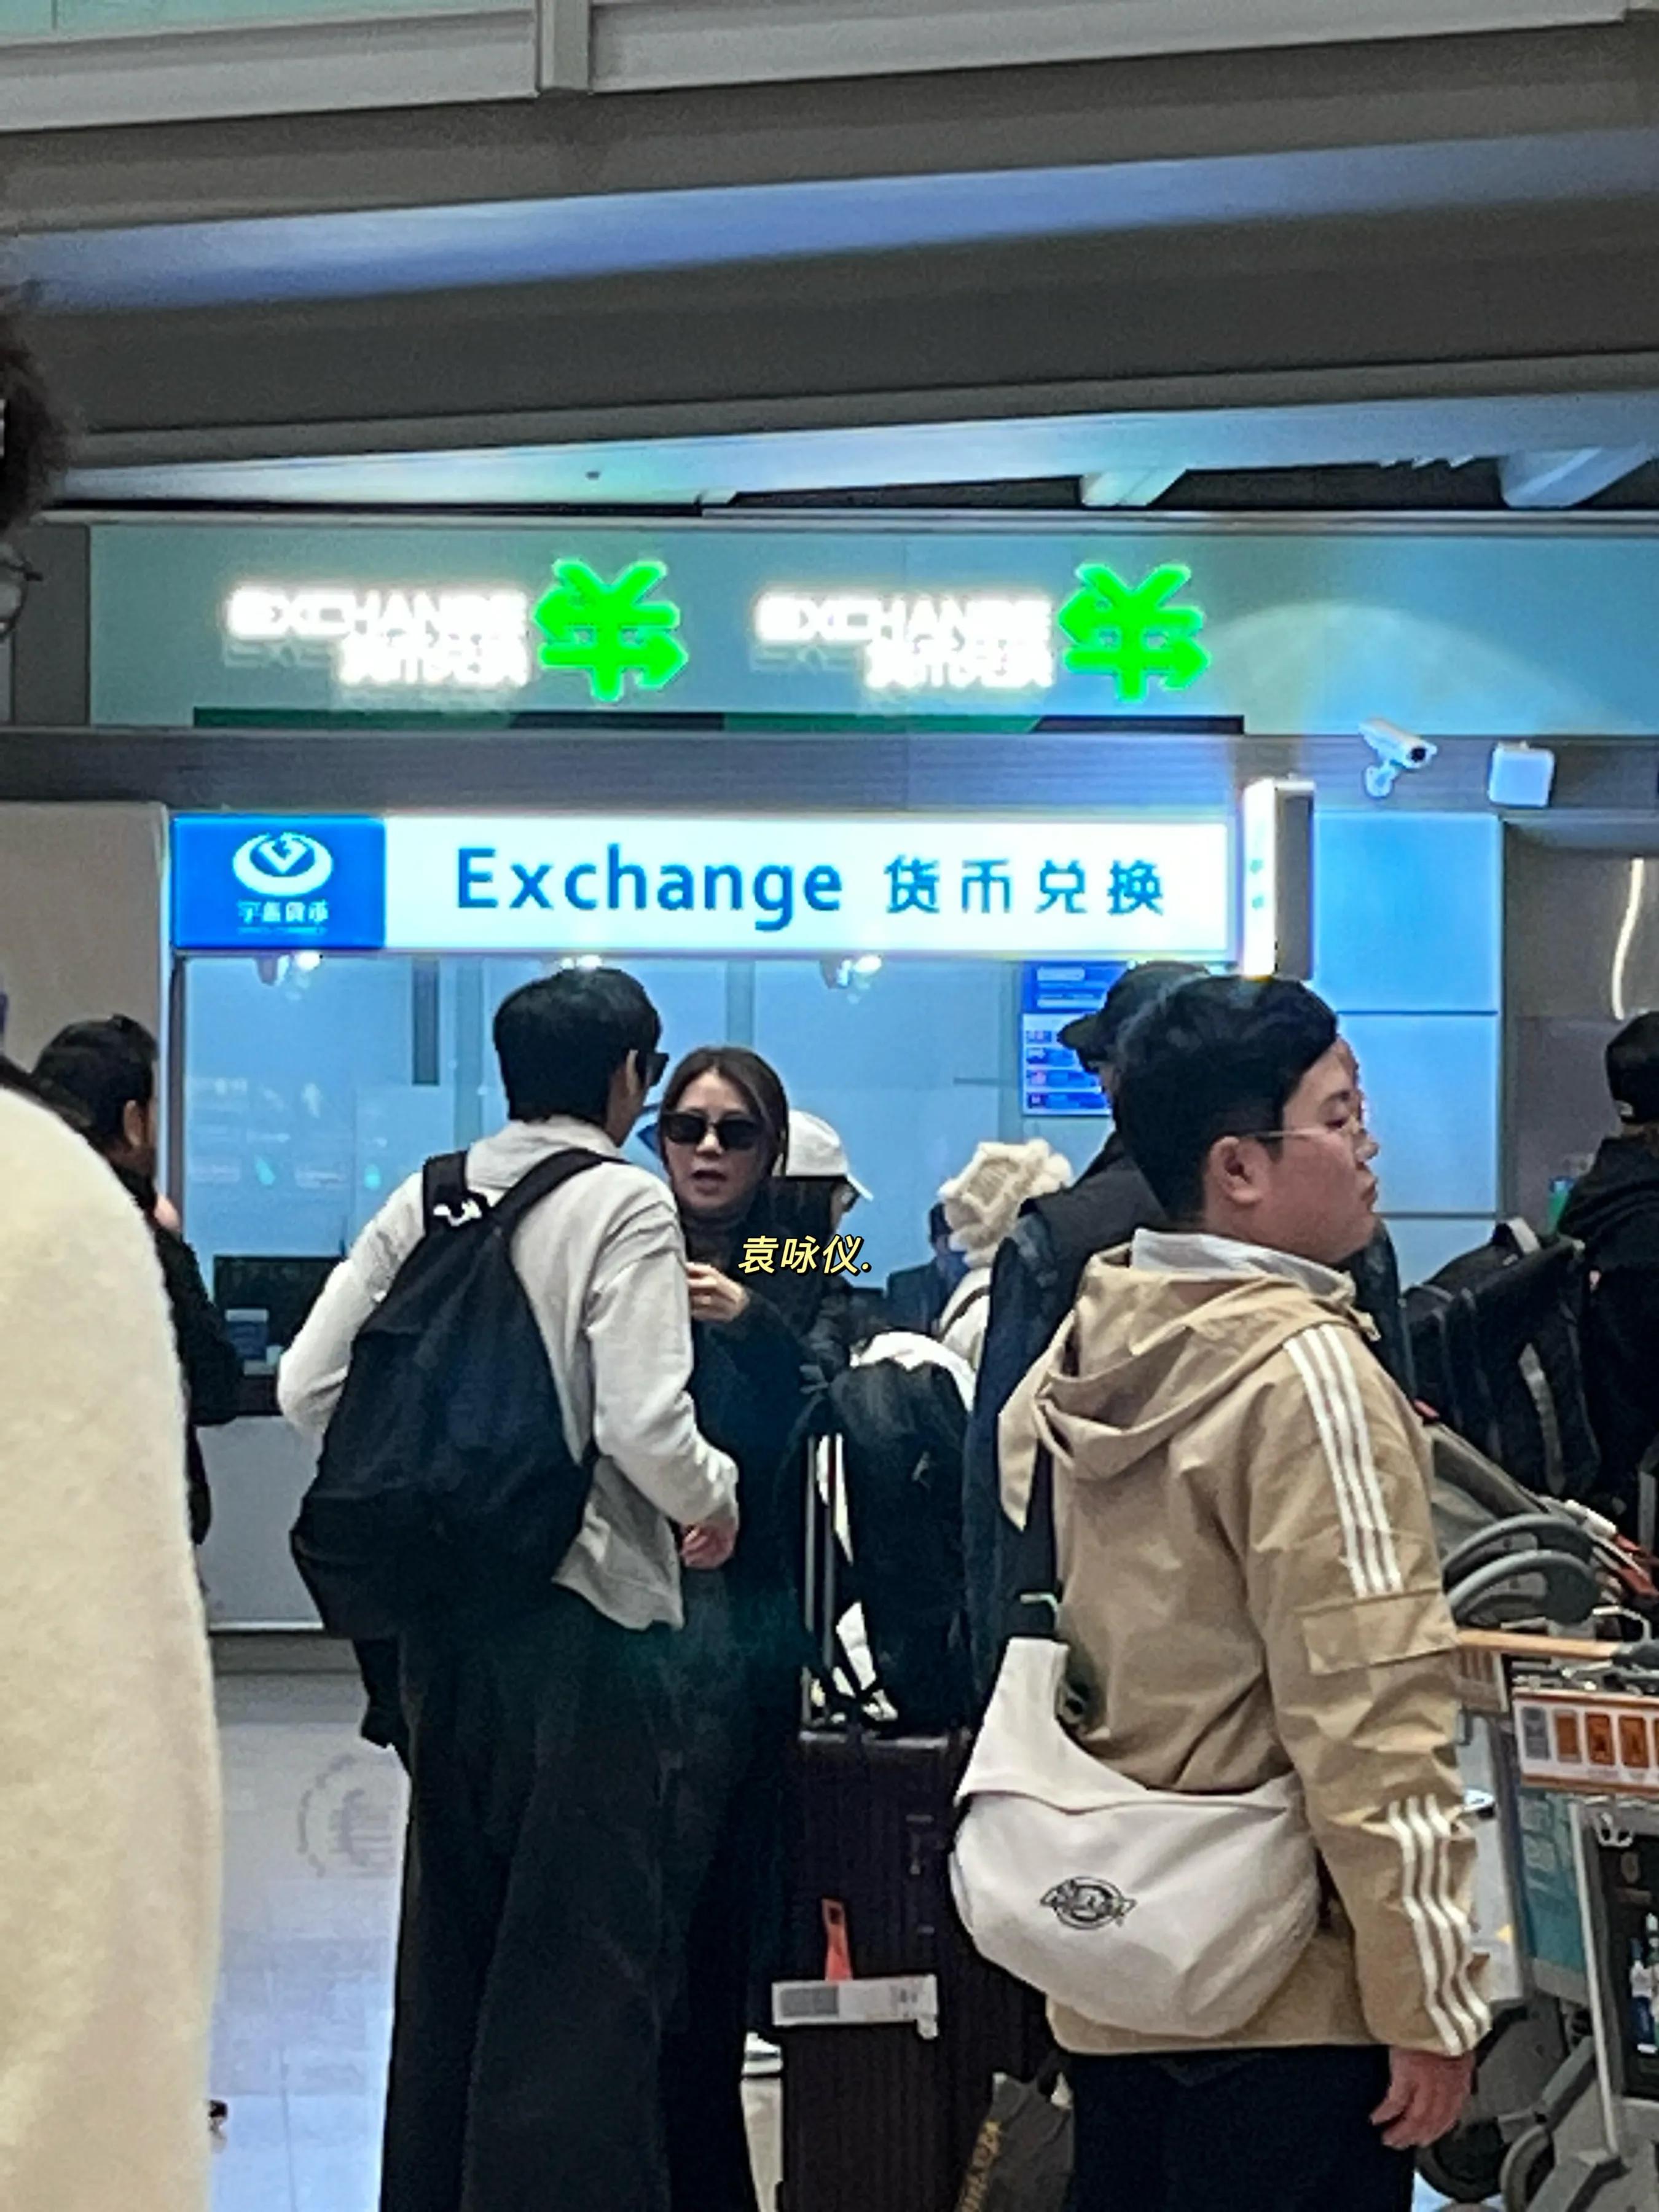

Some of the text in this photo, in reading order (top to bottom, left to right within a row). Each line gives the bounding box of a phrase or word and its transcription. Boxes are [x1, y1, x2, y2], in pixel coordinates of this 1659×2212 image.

[457, 843, 842, 932] Exchange
[884, 855, 1165, 916] 货币兑换
